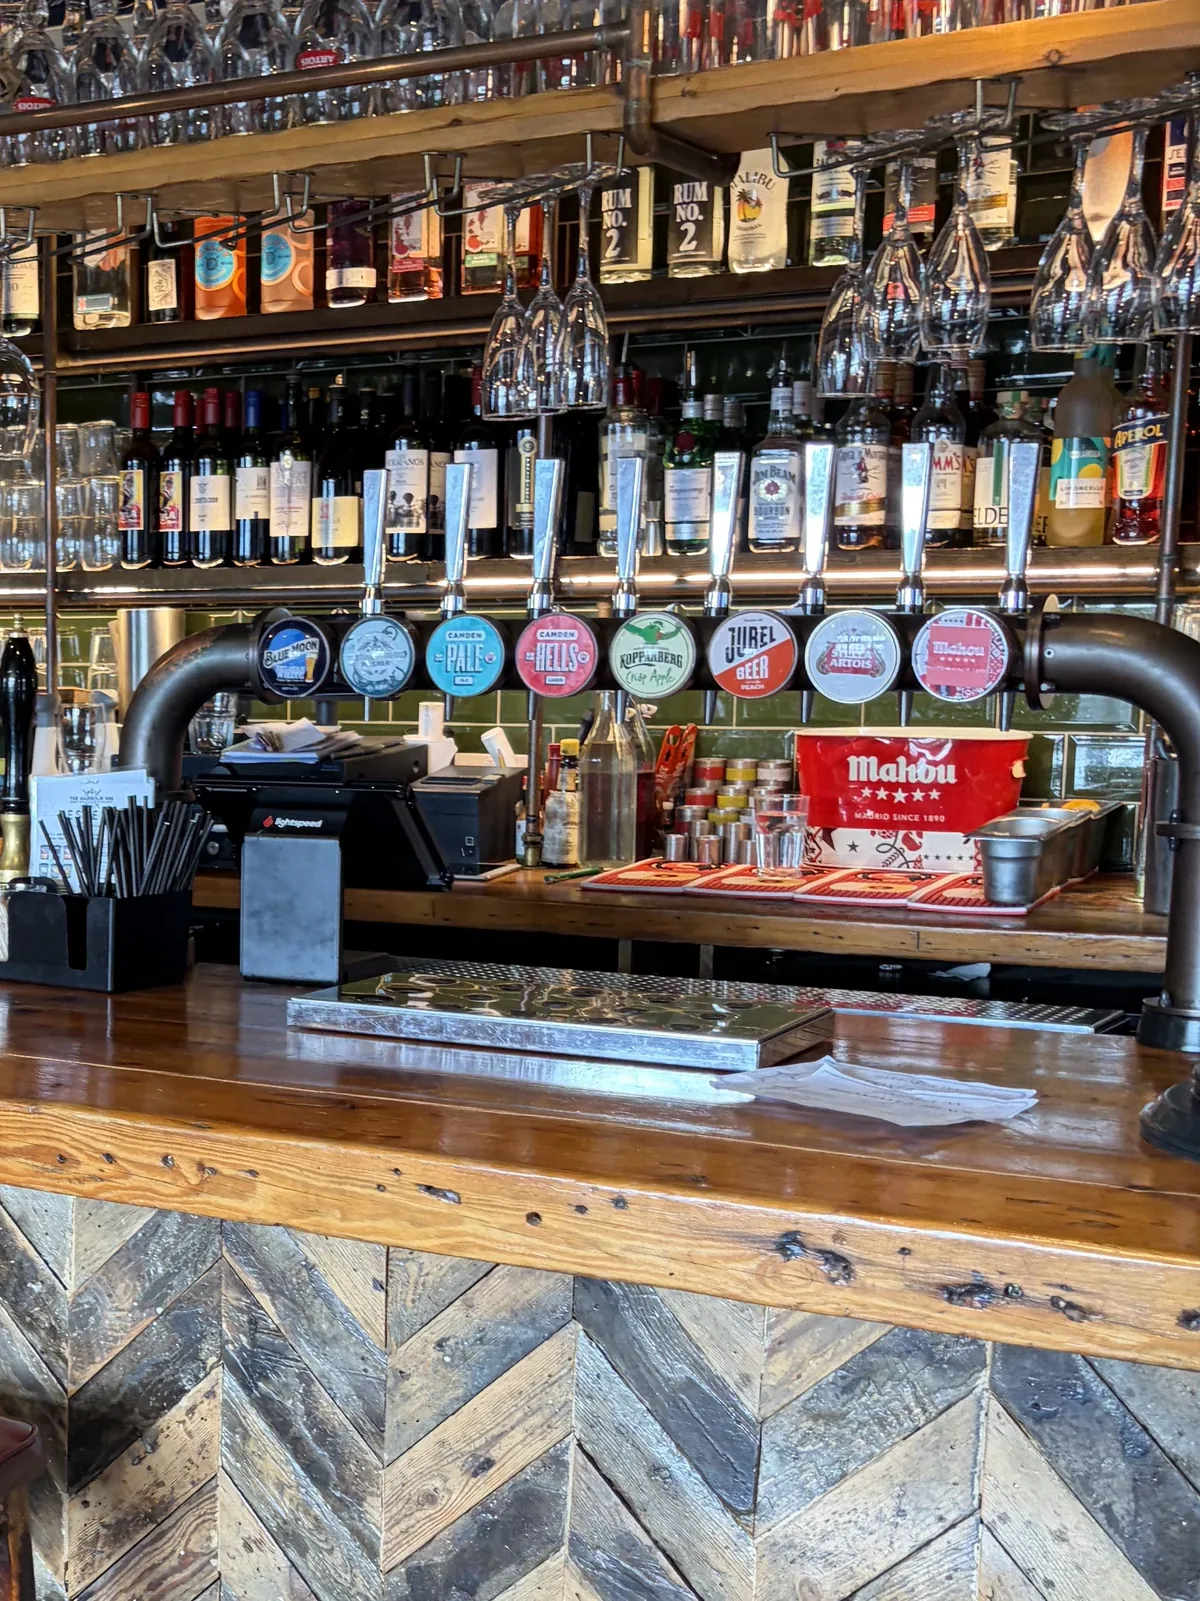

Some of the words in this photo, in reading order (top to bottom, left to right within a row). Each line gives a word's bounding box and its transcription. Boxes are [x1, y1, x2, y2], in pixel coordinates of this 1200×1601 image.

[601, 188, 632, 211] RUM
[673, 181, 709, 204] RUM
[602, 210, 627, 229] NO.
[675, 203, 704, 222] NO.
[604, 229, 621, 257] 2
[679, 222, 698, 251] 2
[1114, 423, 1163, 449] APEROL
[933, 452, 961, 471] MM'S
[448, 632, 483, 640] CAMDEN
[540, 631, 576, 639] CAMDEN
[725, 626, 777, 664] JUBEL
[265, 650, 290, 666] BLUE
[291, 639, 318, 656] MOON
[445, 642, 484, 673] PALE
[535, 642, 579, 673] HELLS
[619, 650, 683, 669] KOPPARBERG
[829, 657, 873, 669] ARTOIS
[625, 671, 648, 685] Crisp
[649, 667, 676, 687] Apple
[736, 655, 769, 680] BEER
[846, 755, 958, 784] Mahou
[274, 817, 323, 828] lightspeed
[854, 811, 890, 822] MADRID
[892, 812, 920, 822] SINCE
[923, 813, 946, 823] 1890
